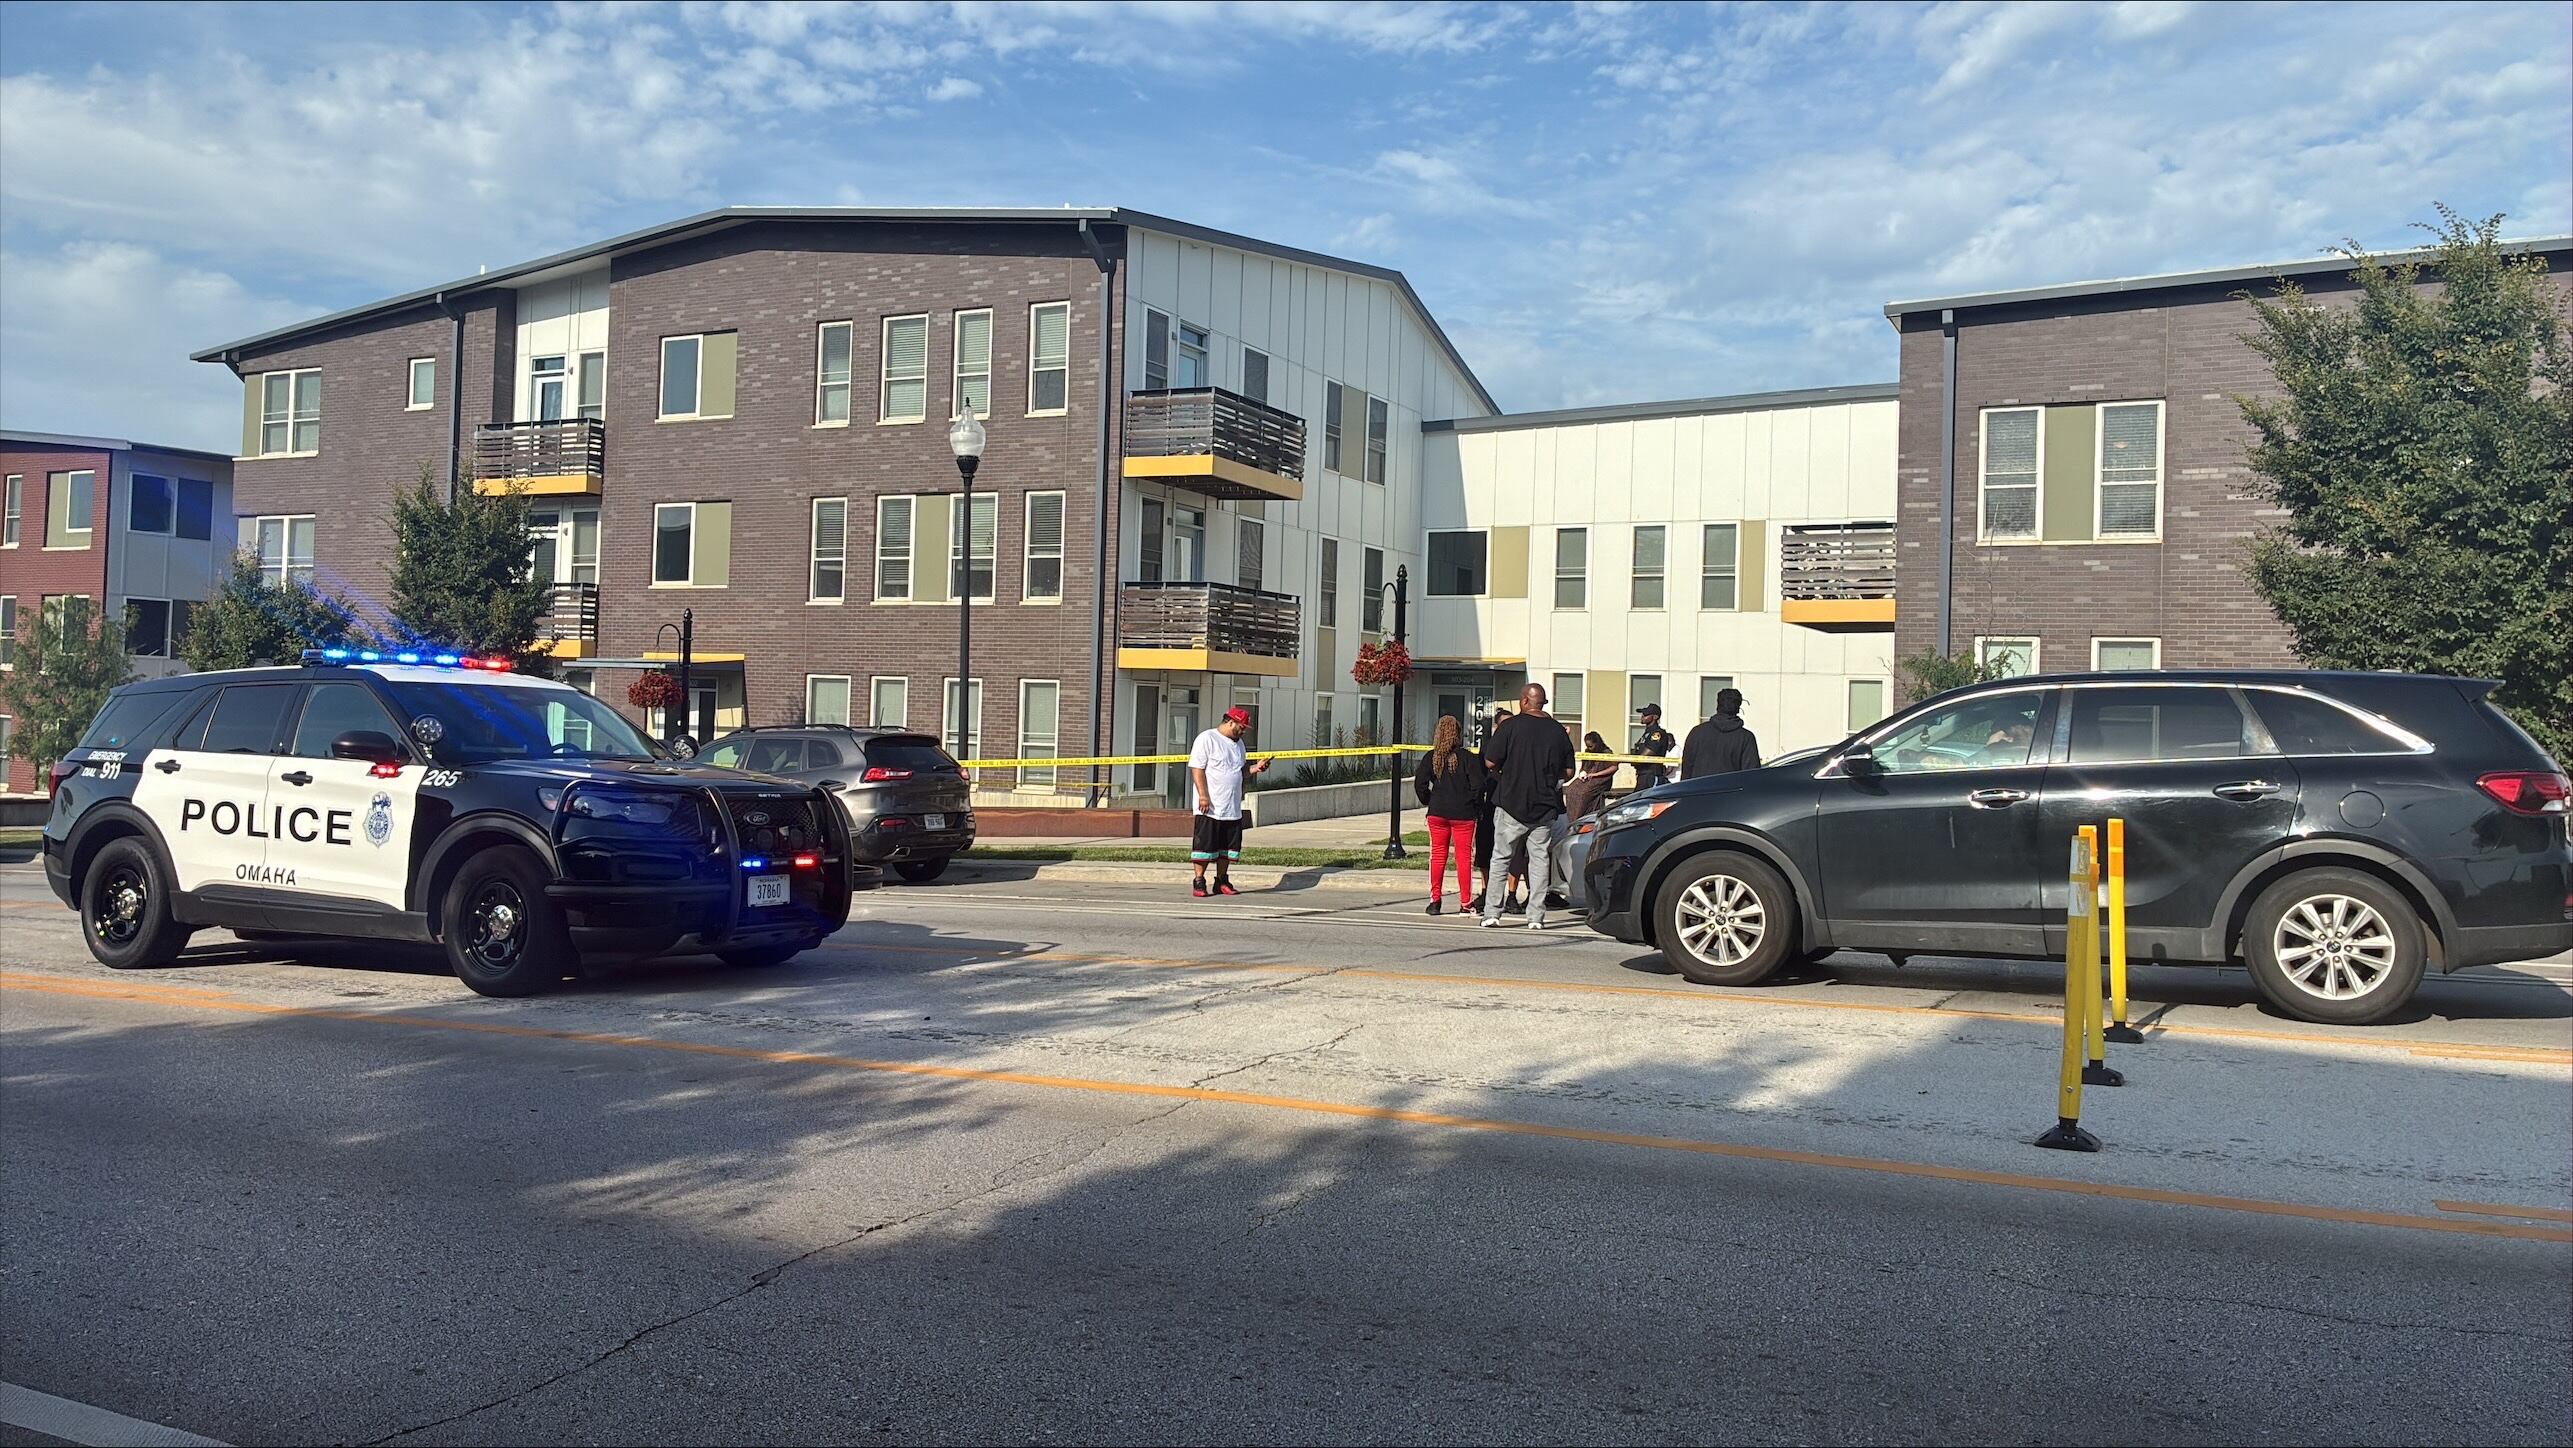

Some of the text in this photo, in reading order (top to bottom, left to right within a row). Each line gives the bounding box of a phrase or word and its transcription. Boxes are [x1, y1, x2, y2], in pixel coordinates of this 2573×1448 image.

[88, 751, 128, 761] EMERGENCY
[81, 761, 121, 780] DIAL 911
[421, 769, 463, 787] 265
[181, 798, 352, 845] POLICE
[236, 864, 296, 885] OMAHA
[757, 884, 781, 900] 37860
